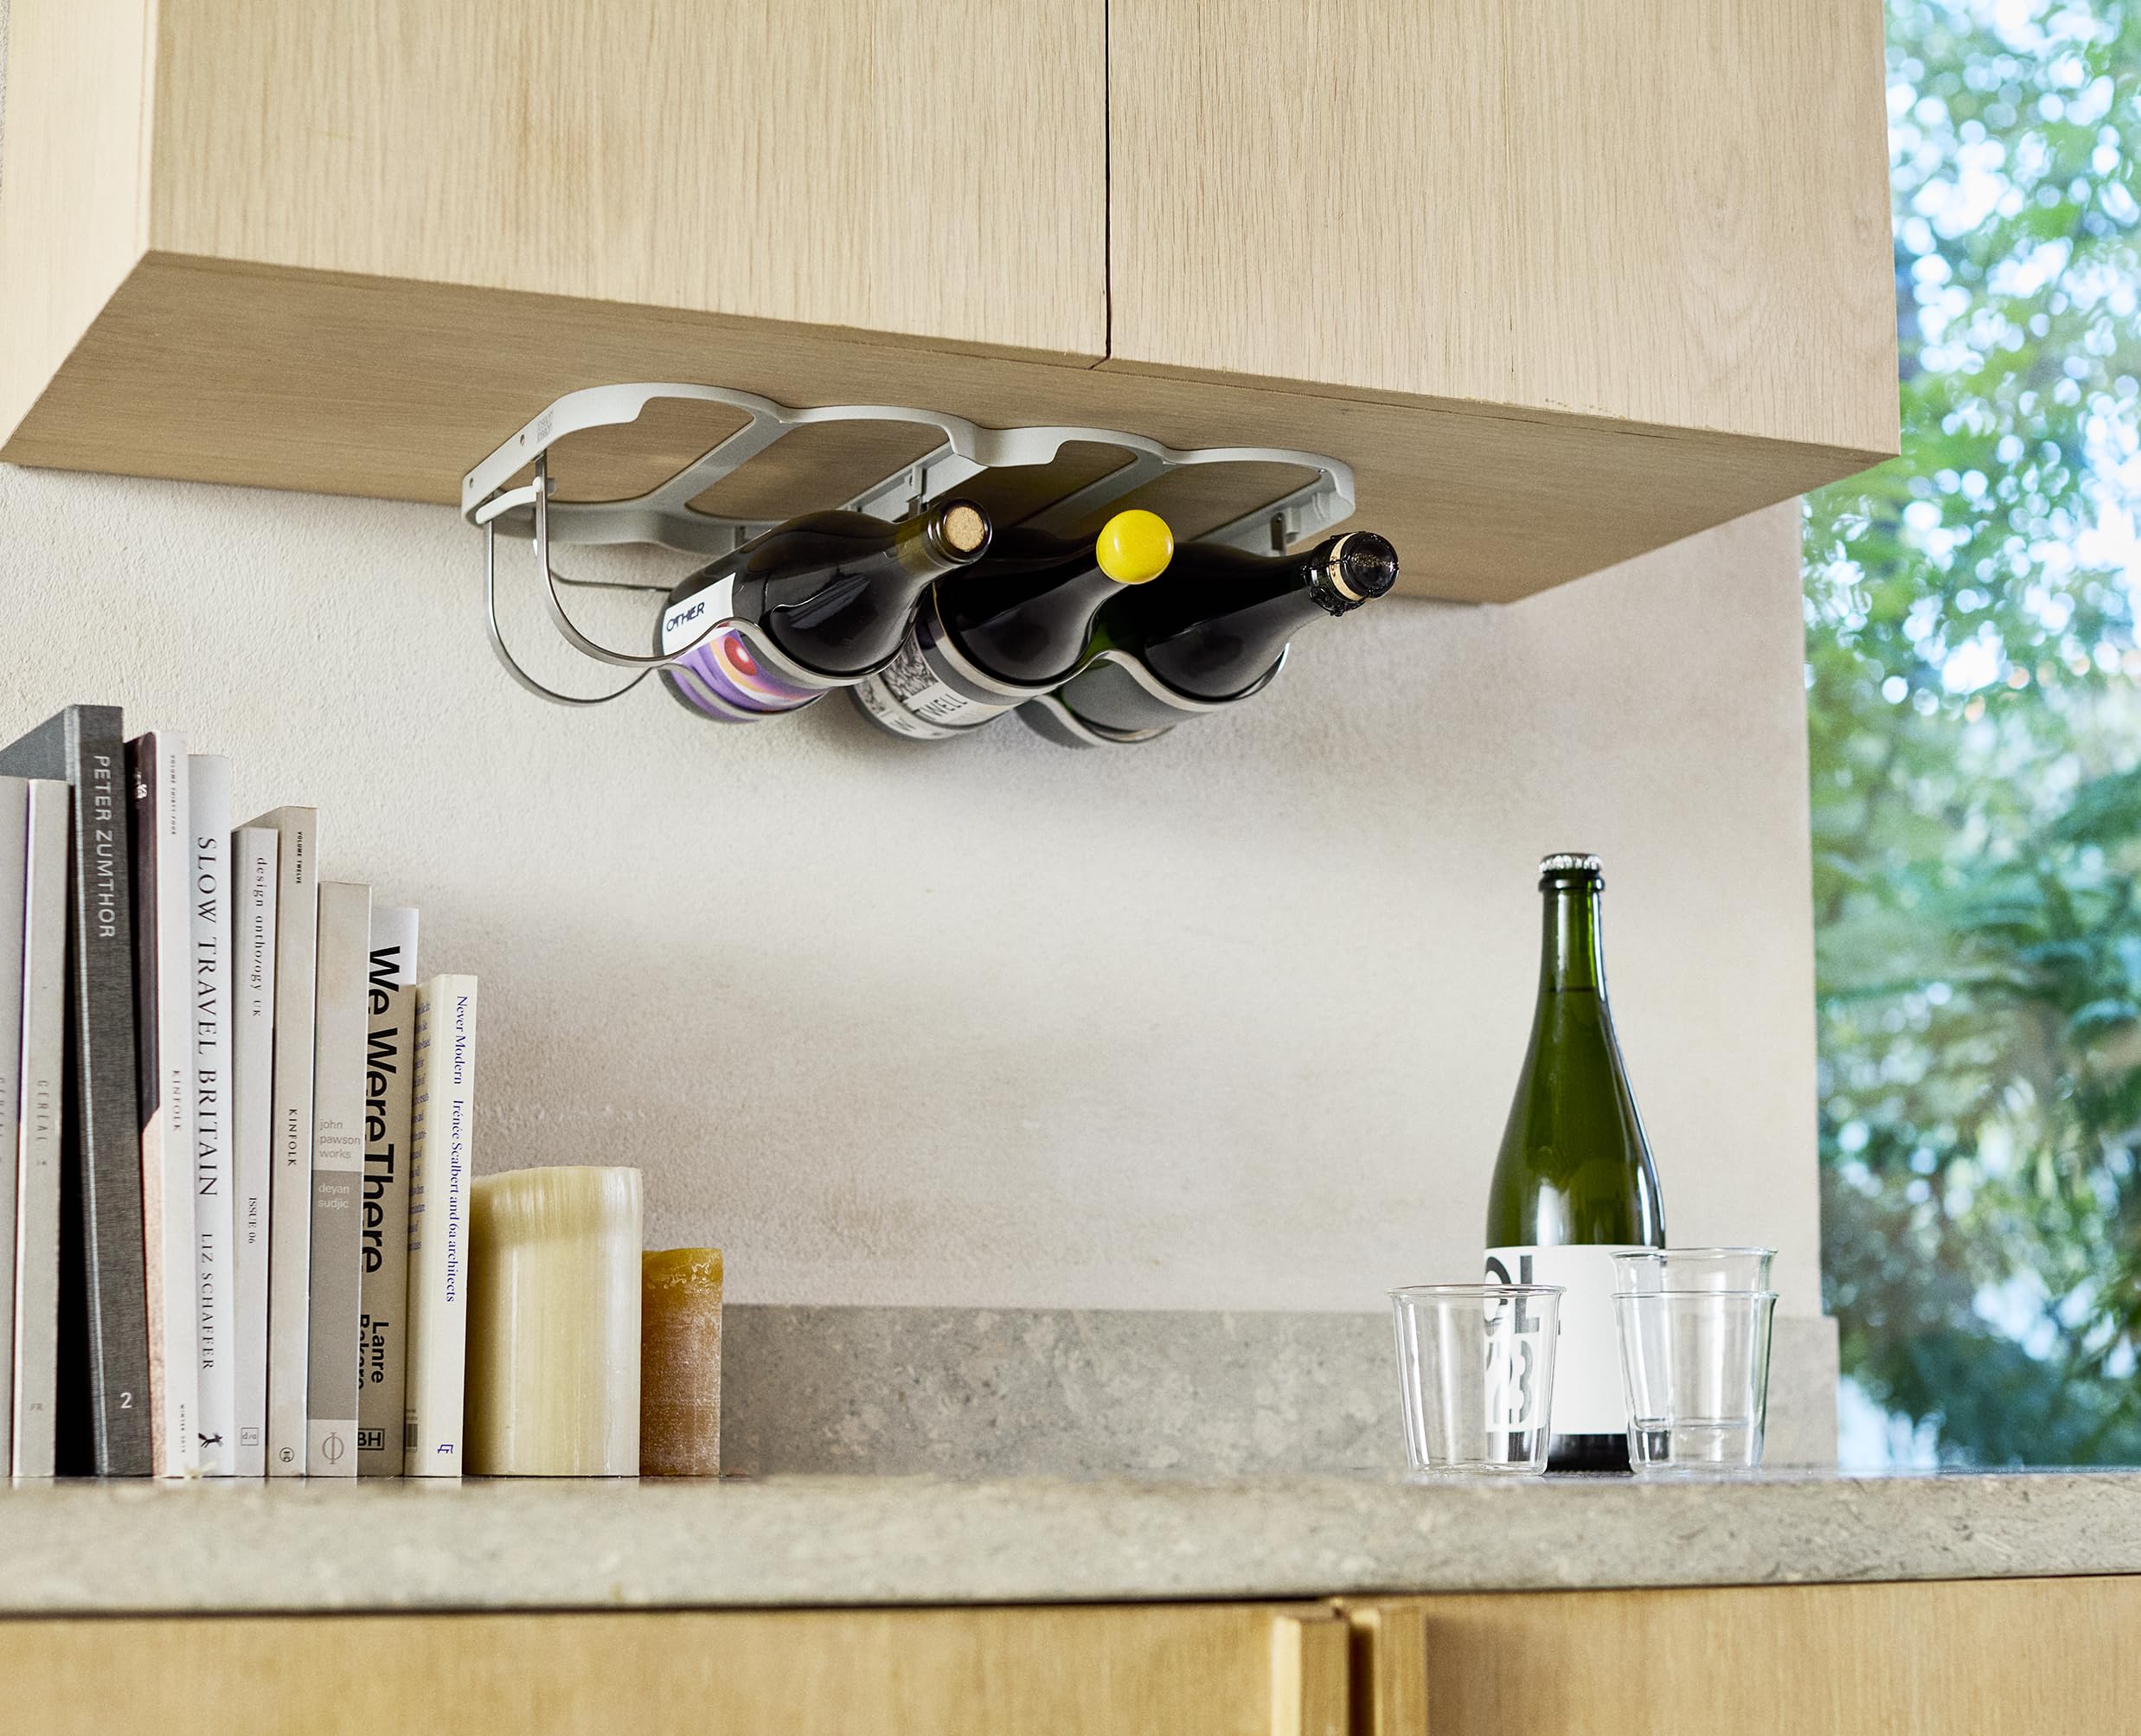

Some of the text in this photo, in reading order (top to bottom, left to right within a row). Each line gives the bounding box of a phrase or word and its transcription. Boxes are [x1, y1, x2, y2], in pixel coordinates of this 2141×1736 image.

[666, 601, 705, 631] OTHER
[93, 755, 116, 938] PETER ZUMTHOR
[253, 857, 268, 906] design
[251, 915, 266, 991] anthology
[196, 836, 218, 1195] SLOW TRAVEL BRITAIN
[319, 1119, 343, 1131] john
[362, 945, 401, 1273] We Were There
[287, 1108, 298, 1167] KINFOLK
[319, 1150, 351, 1159] works
[320, 1136, 361, 1145] pawson
[446, 996, 468, 1303] Never Modern Irénée Scalbert and 6a architects
[318, 1183, 349, 1195] deyan
[318, 1199, 349, 1210] sudjic
[248, 1197, 258, 1244] ISSUE 06
[201, 1233, 215, 1369] LIZ SCHAFFER
[371, 1322, 389, 1384] Lanre
[120, 1392, 132, 1409] 2
[358, 1432, 381, 1447] BH
